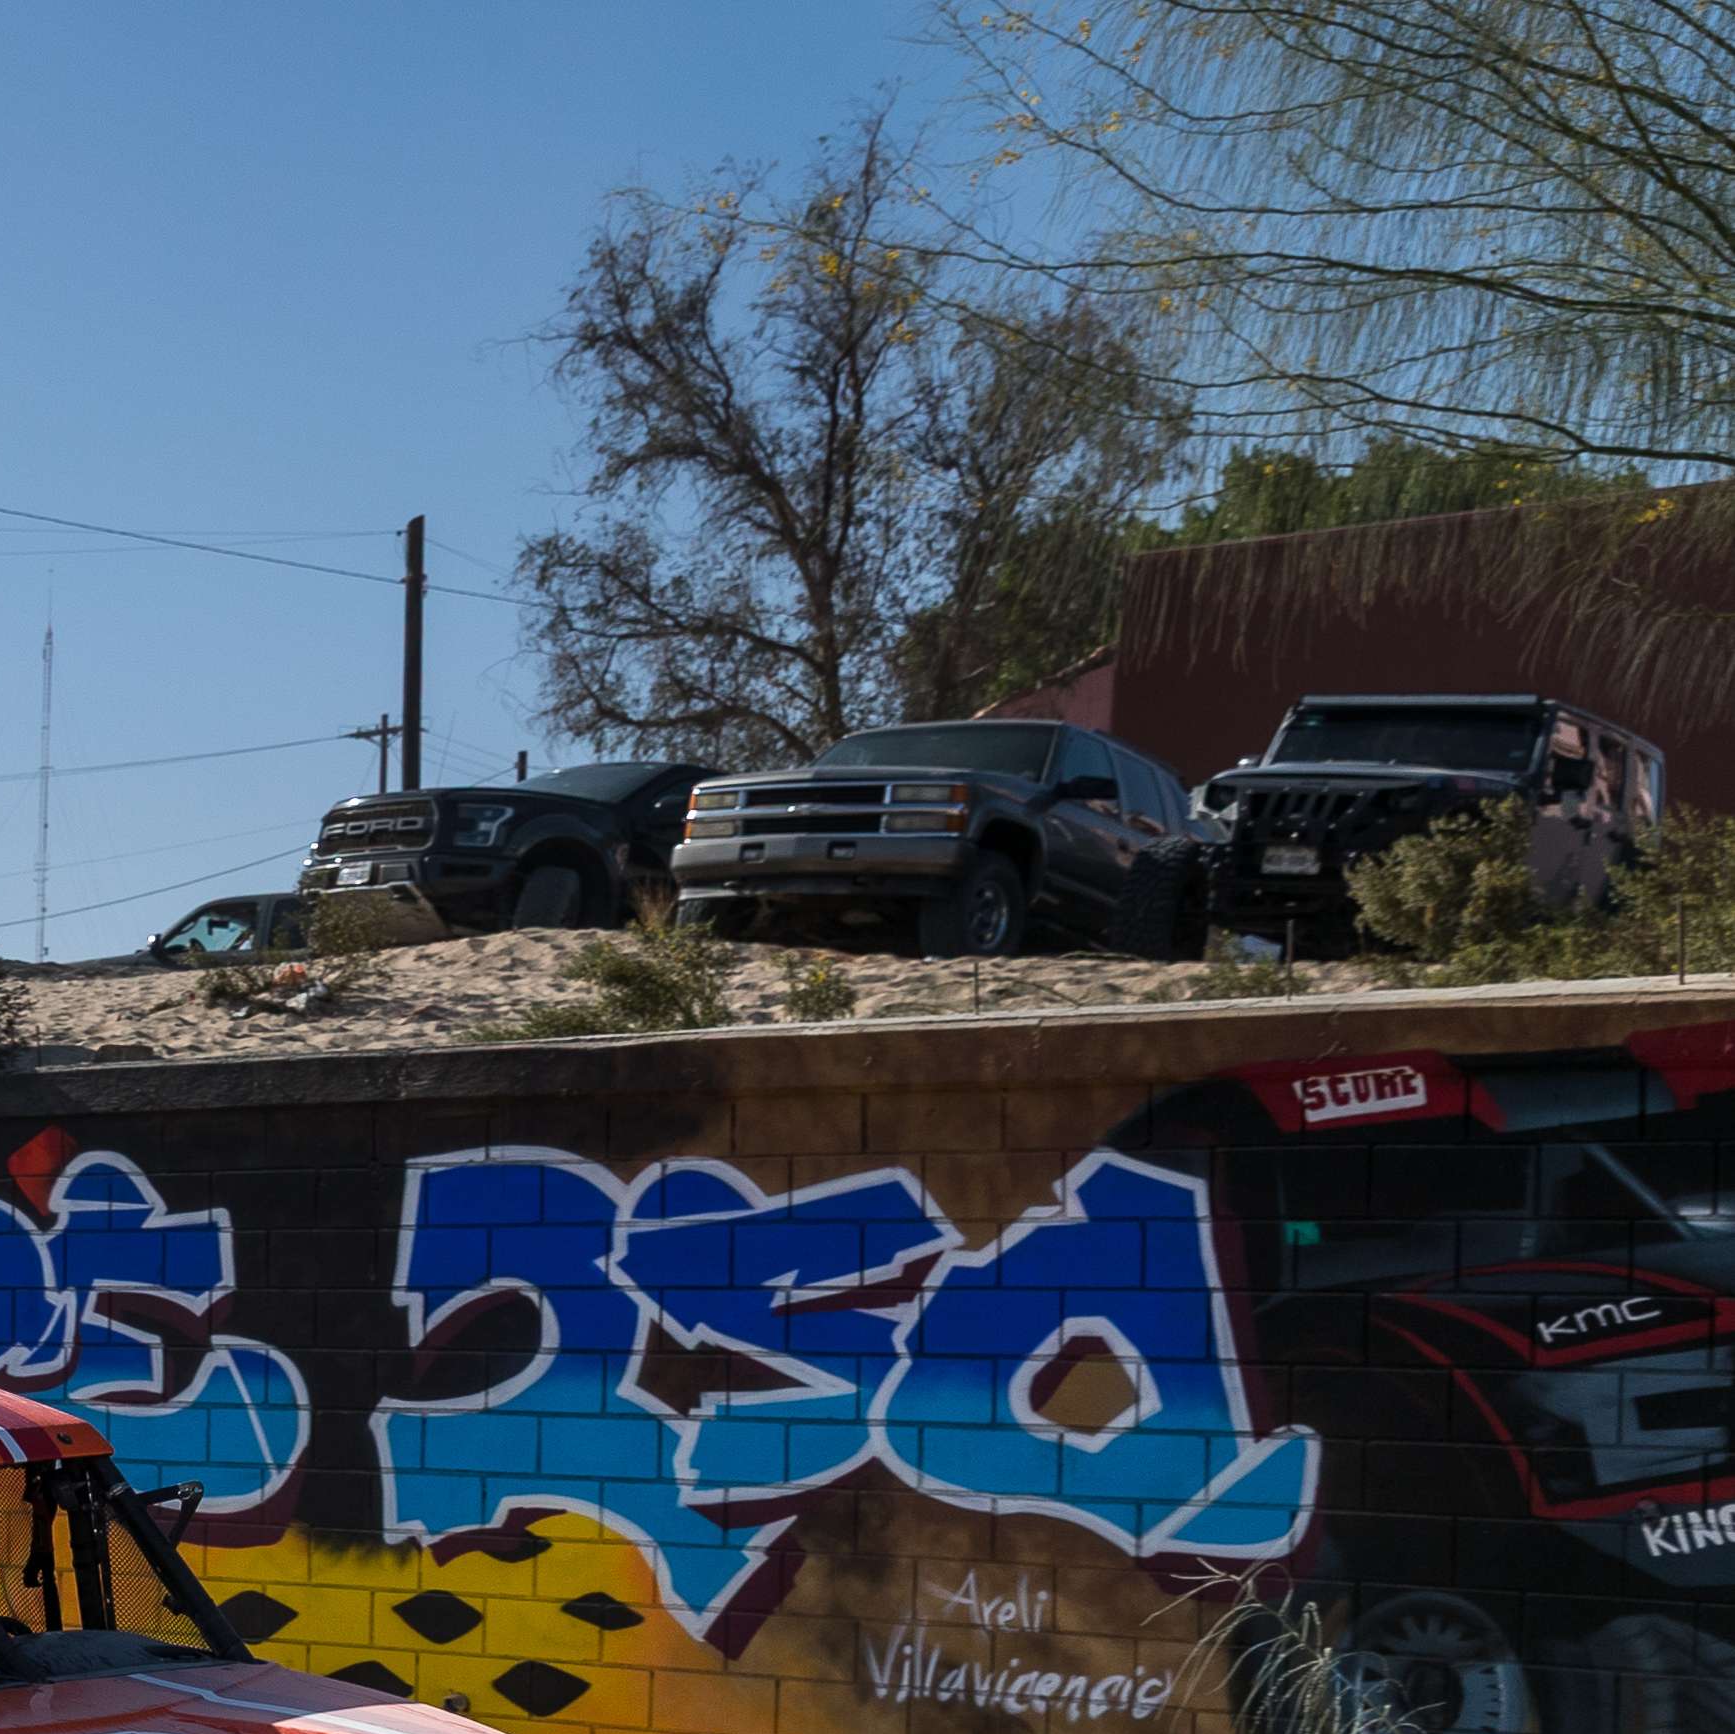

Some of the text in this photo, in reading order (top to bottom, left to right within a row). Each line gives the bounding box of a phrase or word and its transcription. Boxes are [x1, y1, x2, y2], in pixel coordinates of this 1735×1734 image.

[322, 816, 425, 840] FORD
[1537, 1297, 1663, 1343] KMC
[369, 1144, 1322, 1642] 250
